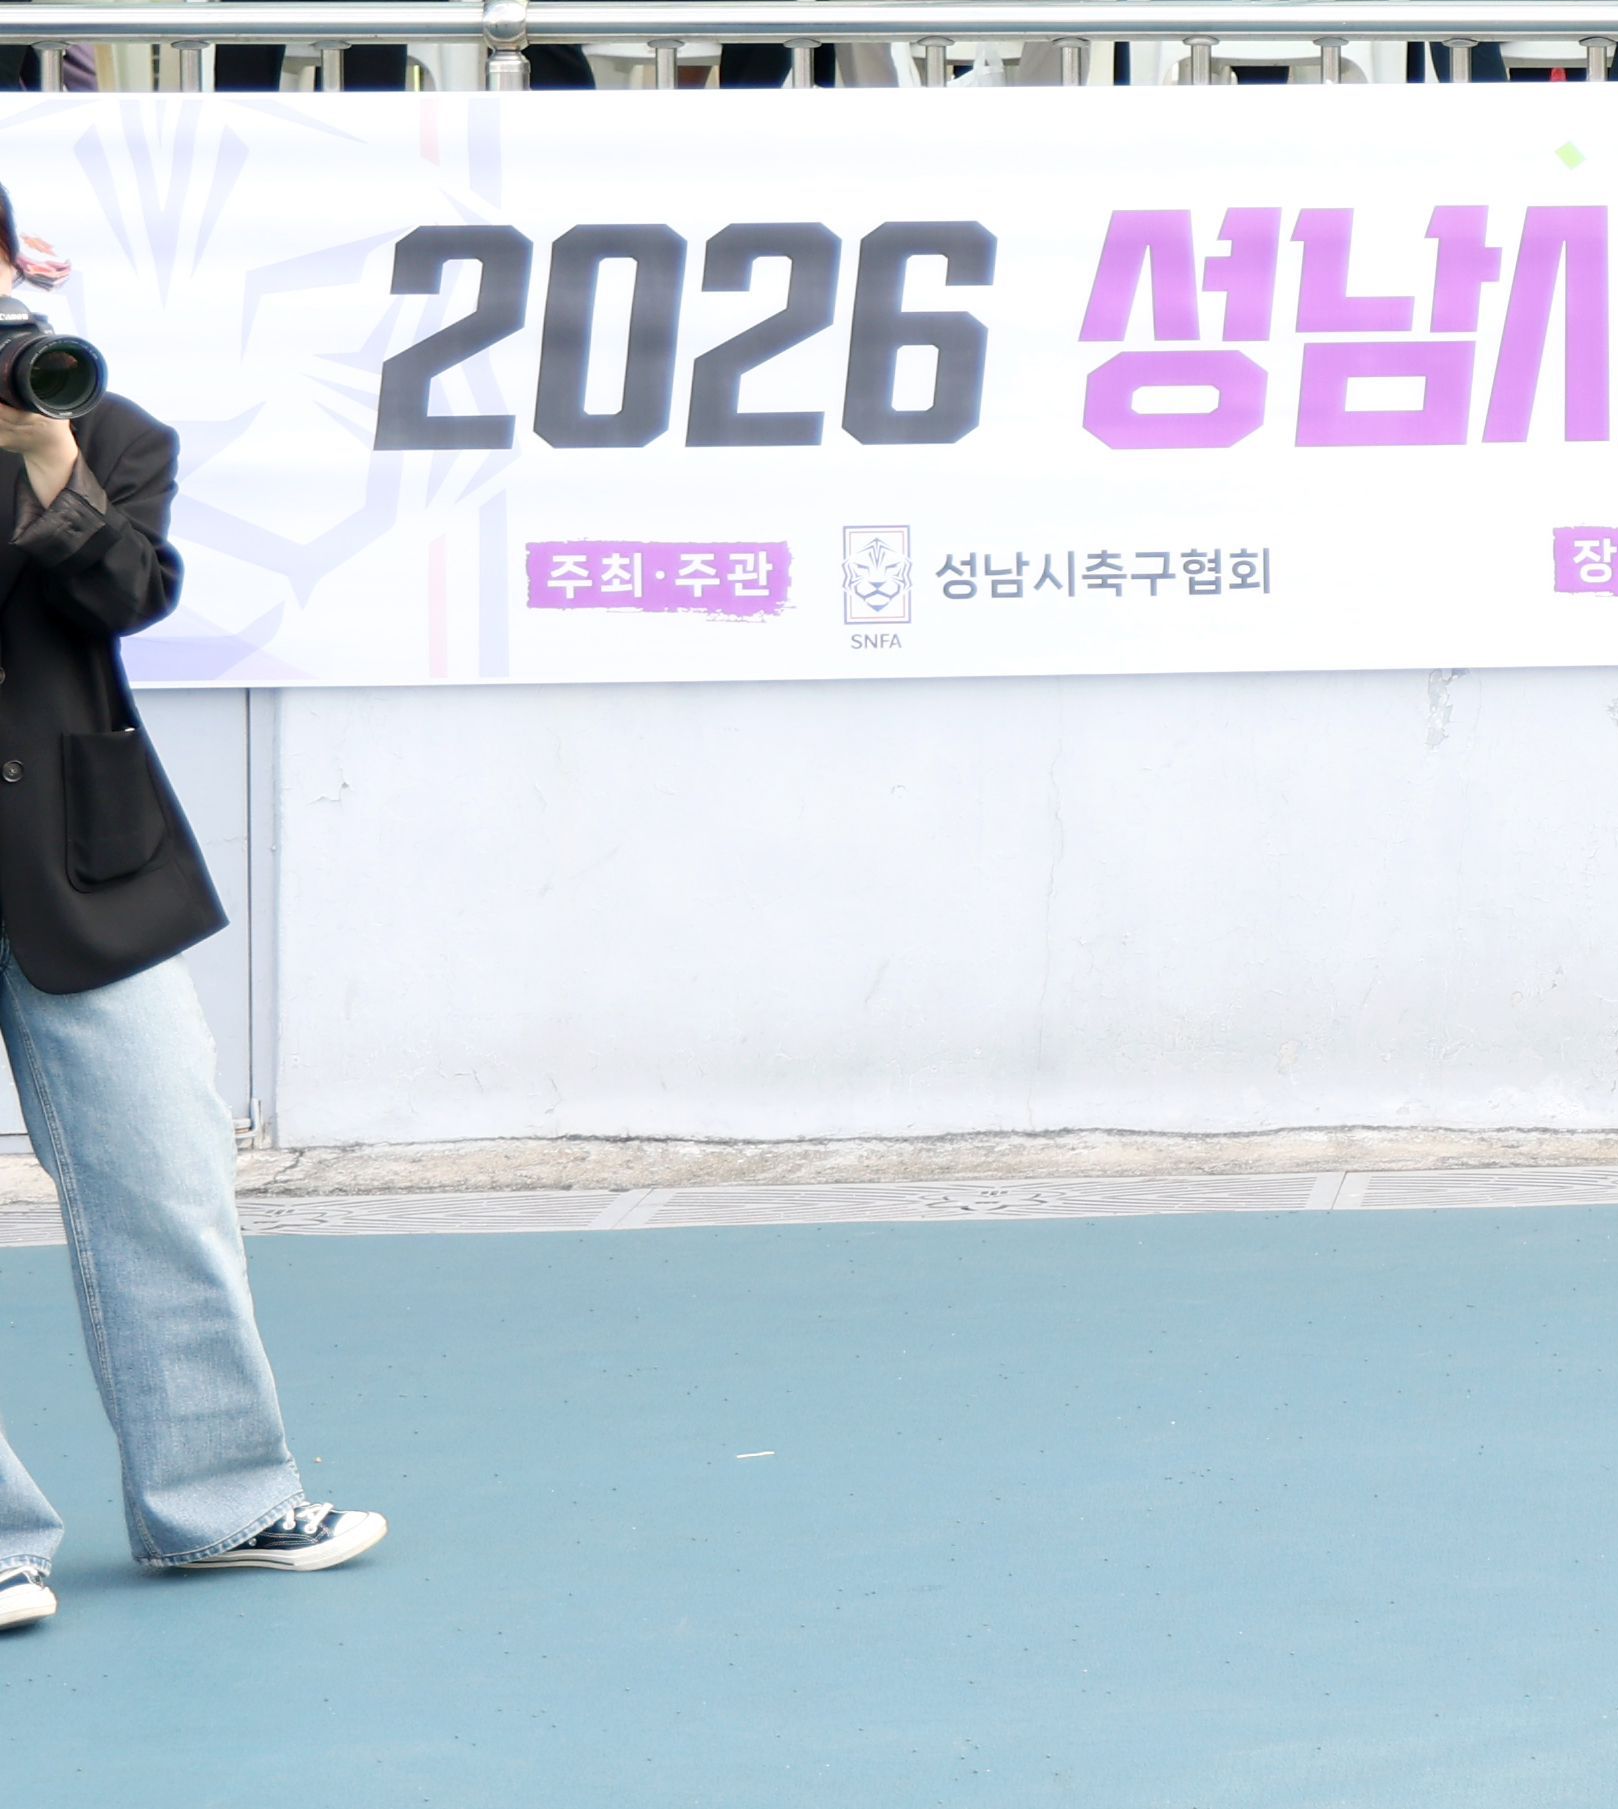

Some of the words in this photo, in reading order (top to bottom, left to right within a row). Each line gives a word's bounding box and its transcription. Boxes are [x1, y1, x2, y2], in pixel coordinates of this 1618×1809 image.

[373, 221, 997, 451] 2026
[935, 547, 1270, 599] 성남시축구협회
[850, 633, 902, 649] SNFA
